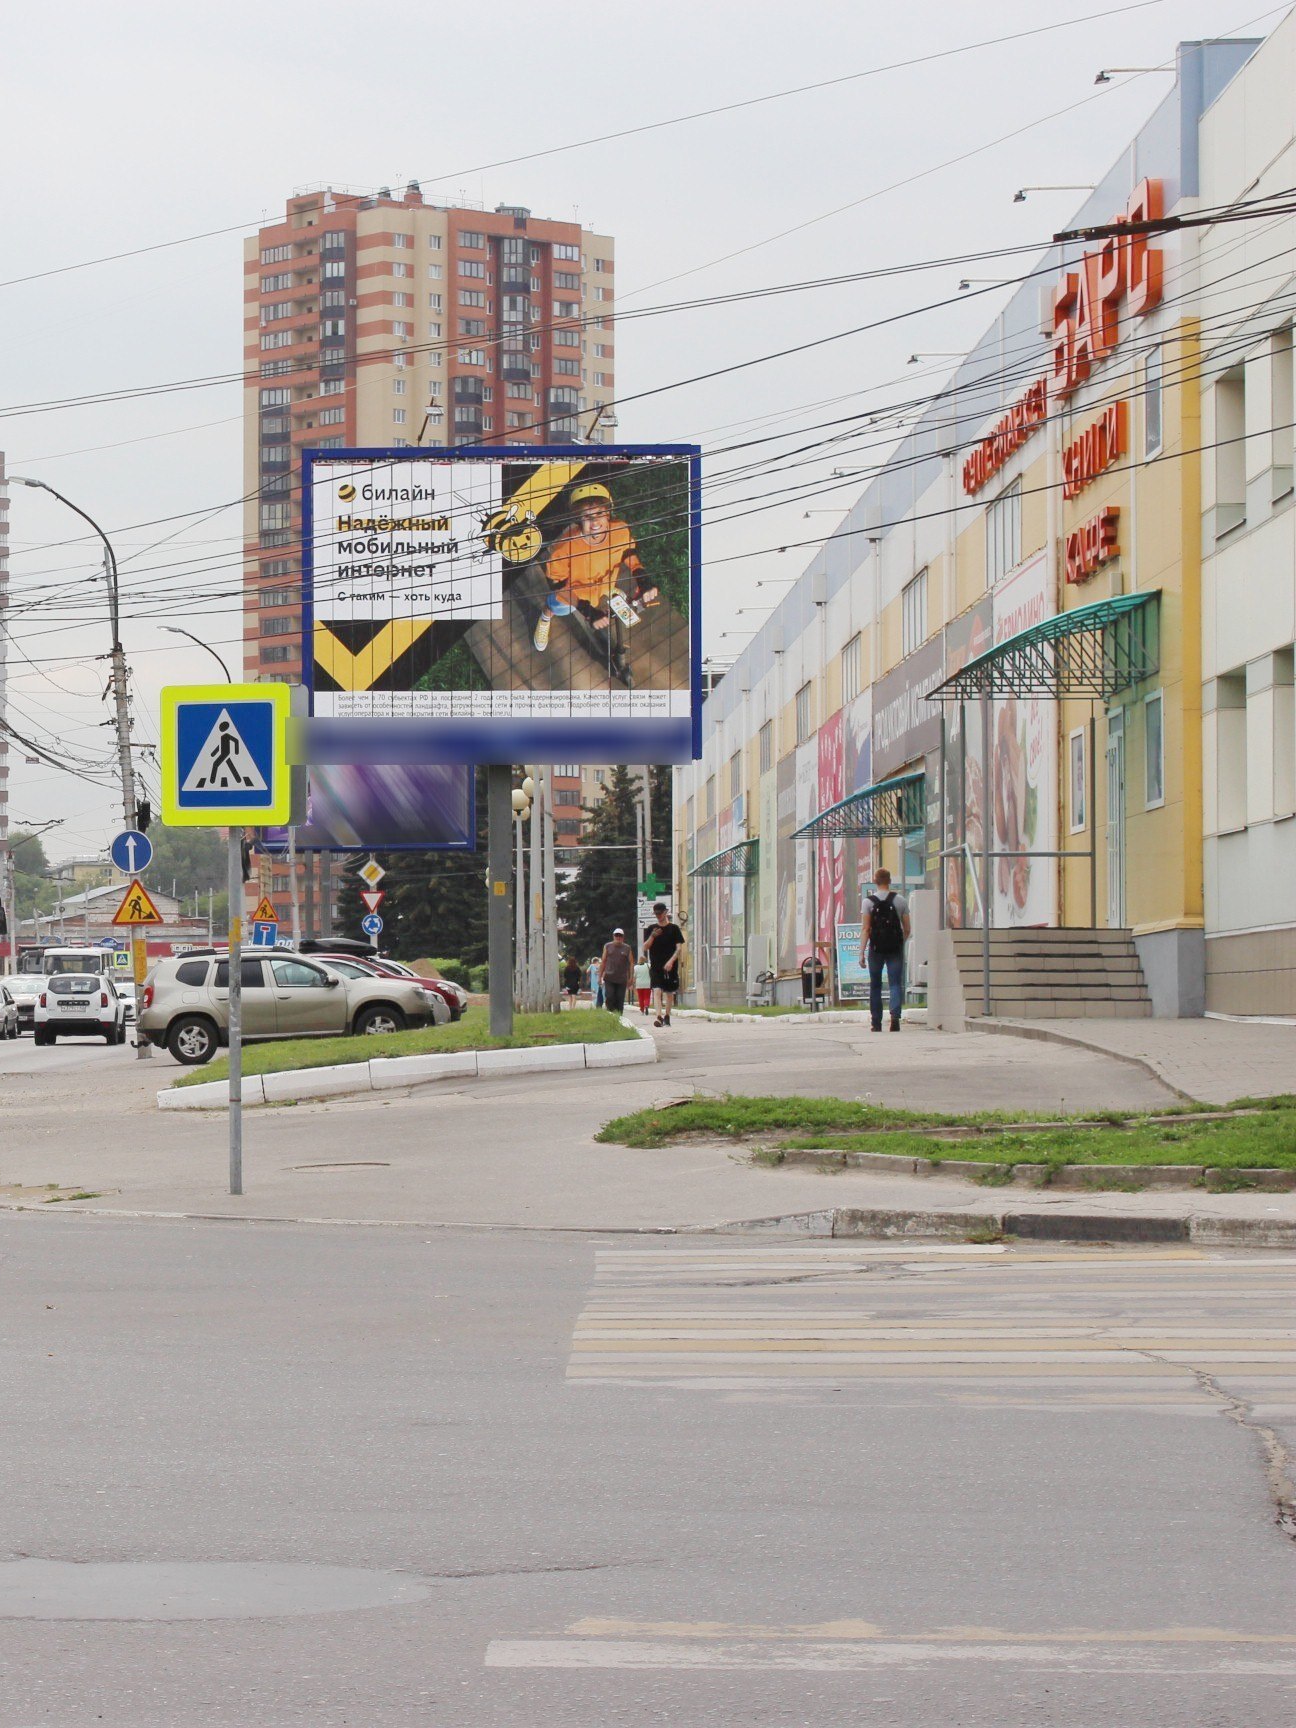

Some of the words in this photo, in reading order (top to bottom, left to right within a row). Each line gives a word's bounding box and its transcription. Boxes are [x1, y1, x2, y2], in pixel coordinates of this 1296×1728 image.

[1051, 176, 1164, 401] БАРС
[962, 373, 1047, 496] СУПЕРМАРКЕТ
[1062, 400, 1128, 500] КНИГИ
[361, 484, 436, 501] билайн
[337, 515, 449, 534] Надёжный
[337, 538, 459, 554] мобильный
[1065, 506, 1120, 586] КАФЕ
[337, 564, 437, 581] интернет
[350, 593, 385, 601] таким
[404, 593, 431, 601] хоть
[434, 593, 462, 603] куда
